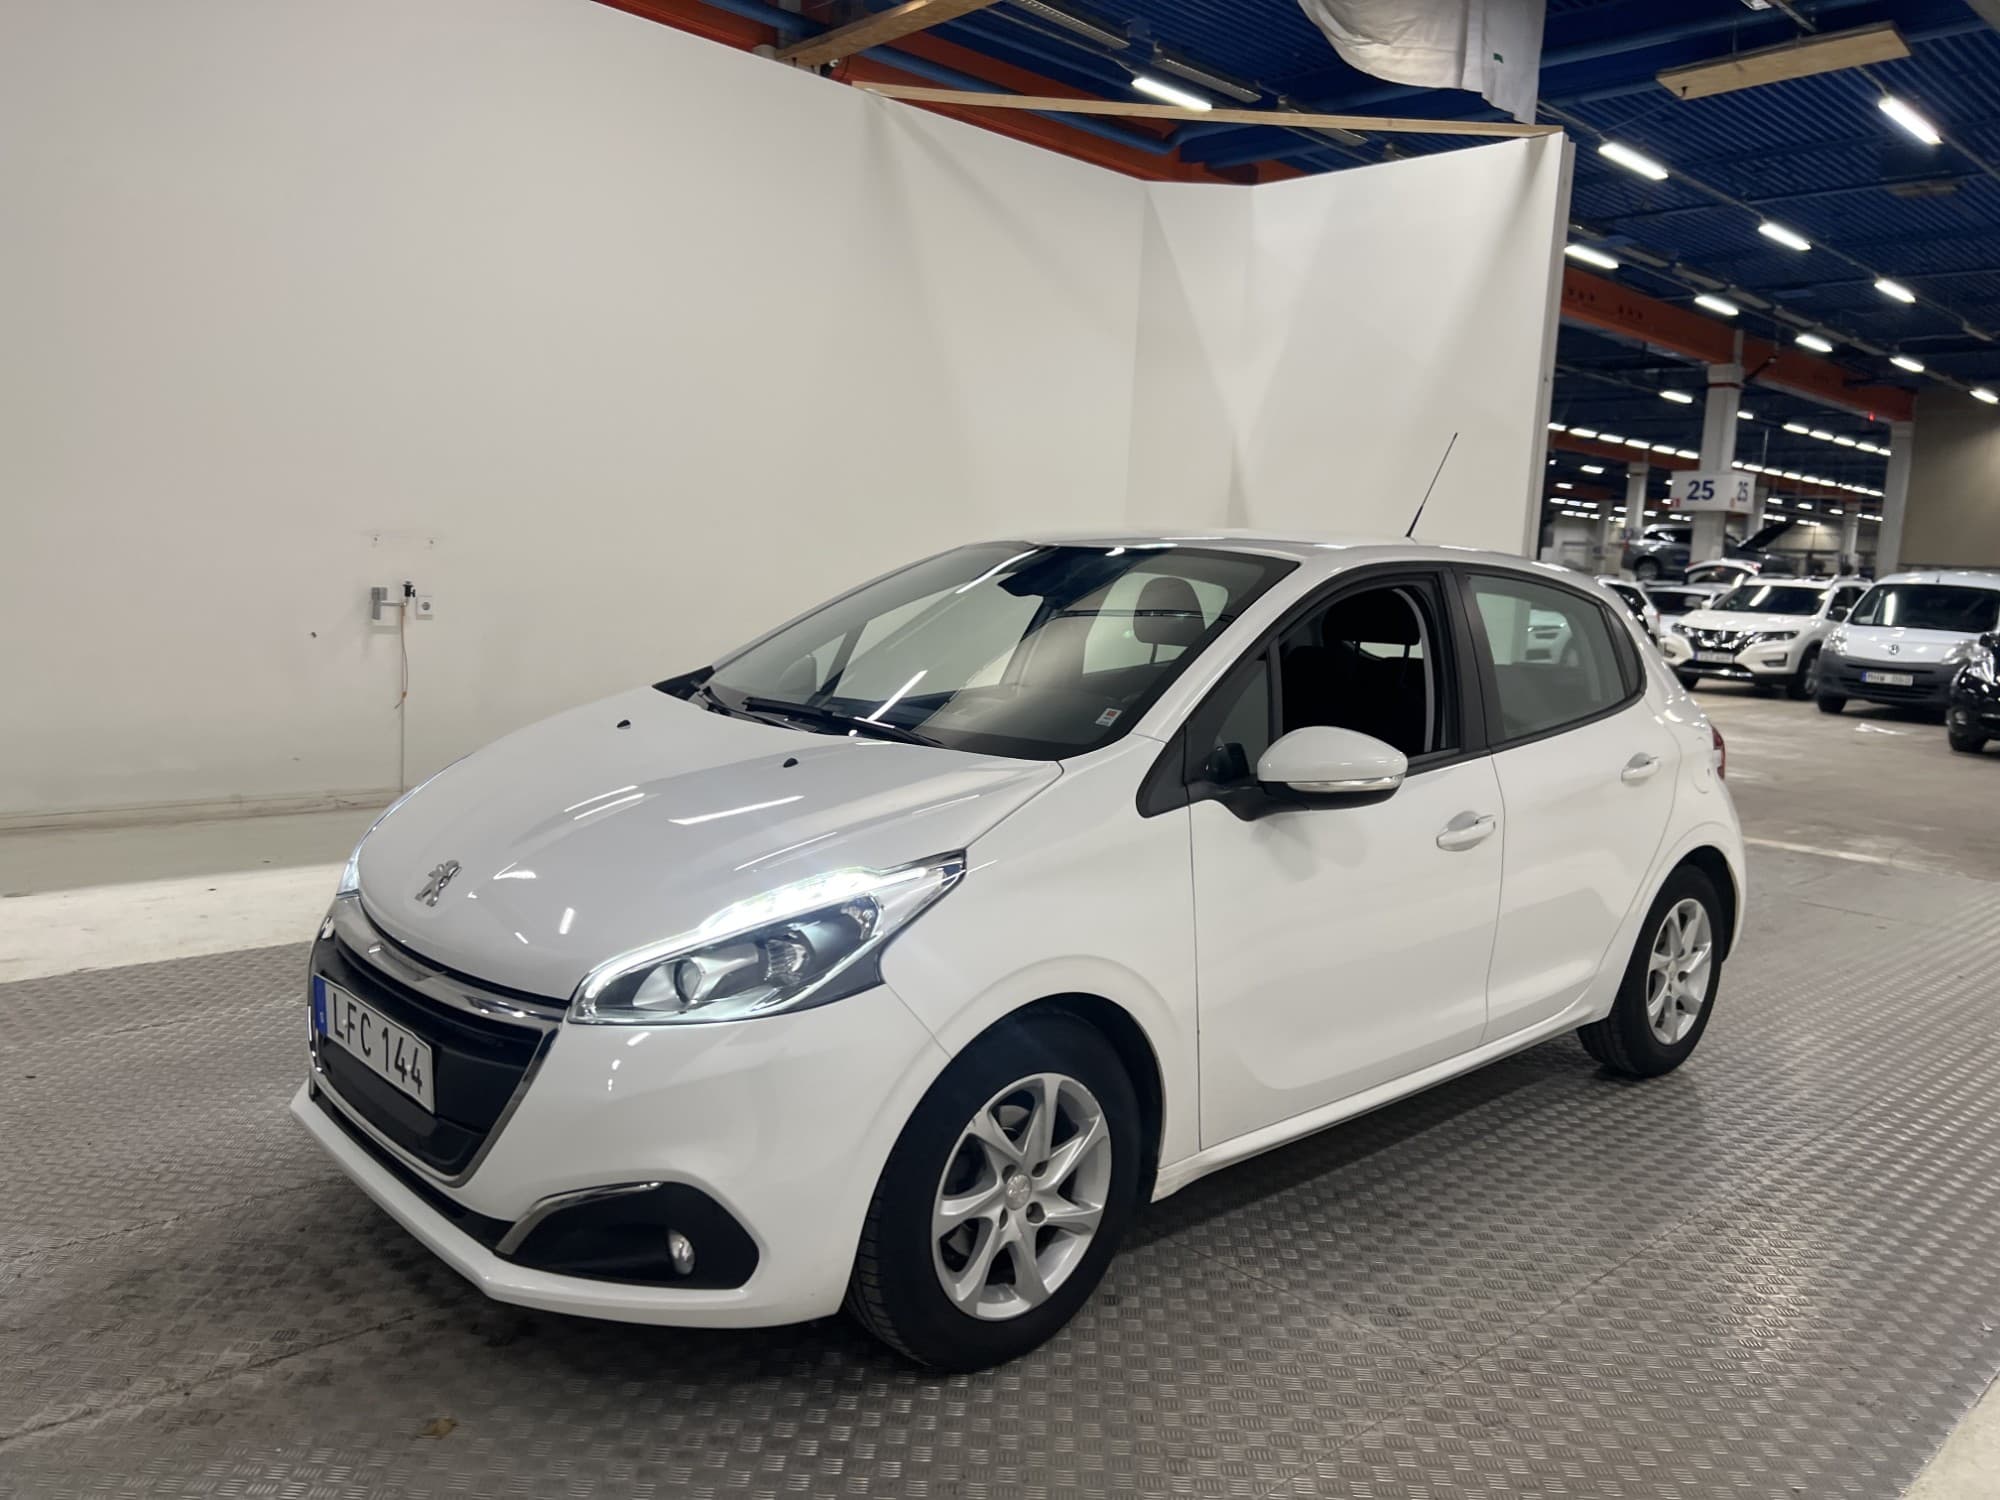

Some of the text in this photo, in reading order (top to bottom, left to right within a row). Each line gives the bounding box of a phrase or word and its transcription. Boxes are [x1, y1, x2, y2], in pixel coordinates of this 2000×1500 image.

[1686, 479, 1715, 501] 25
[333, 993, 423, 1094] LFC 144
